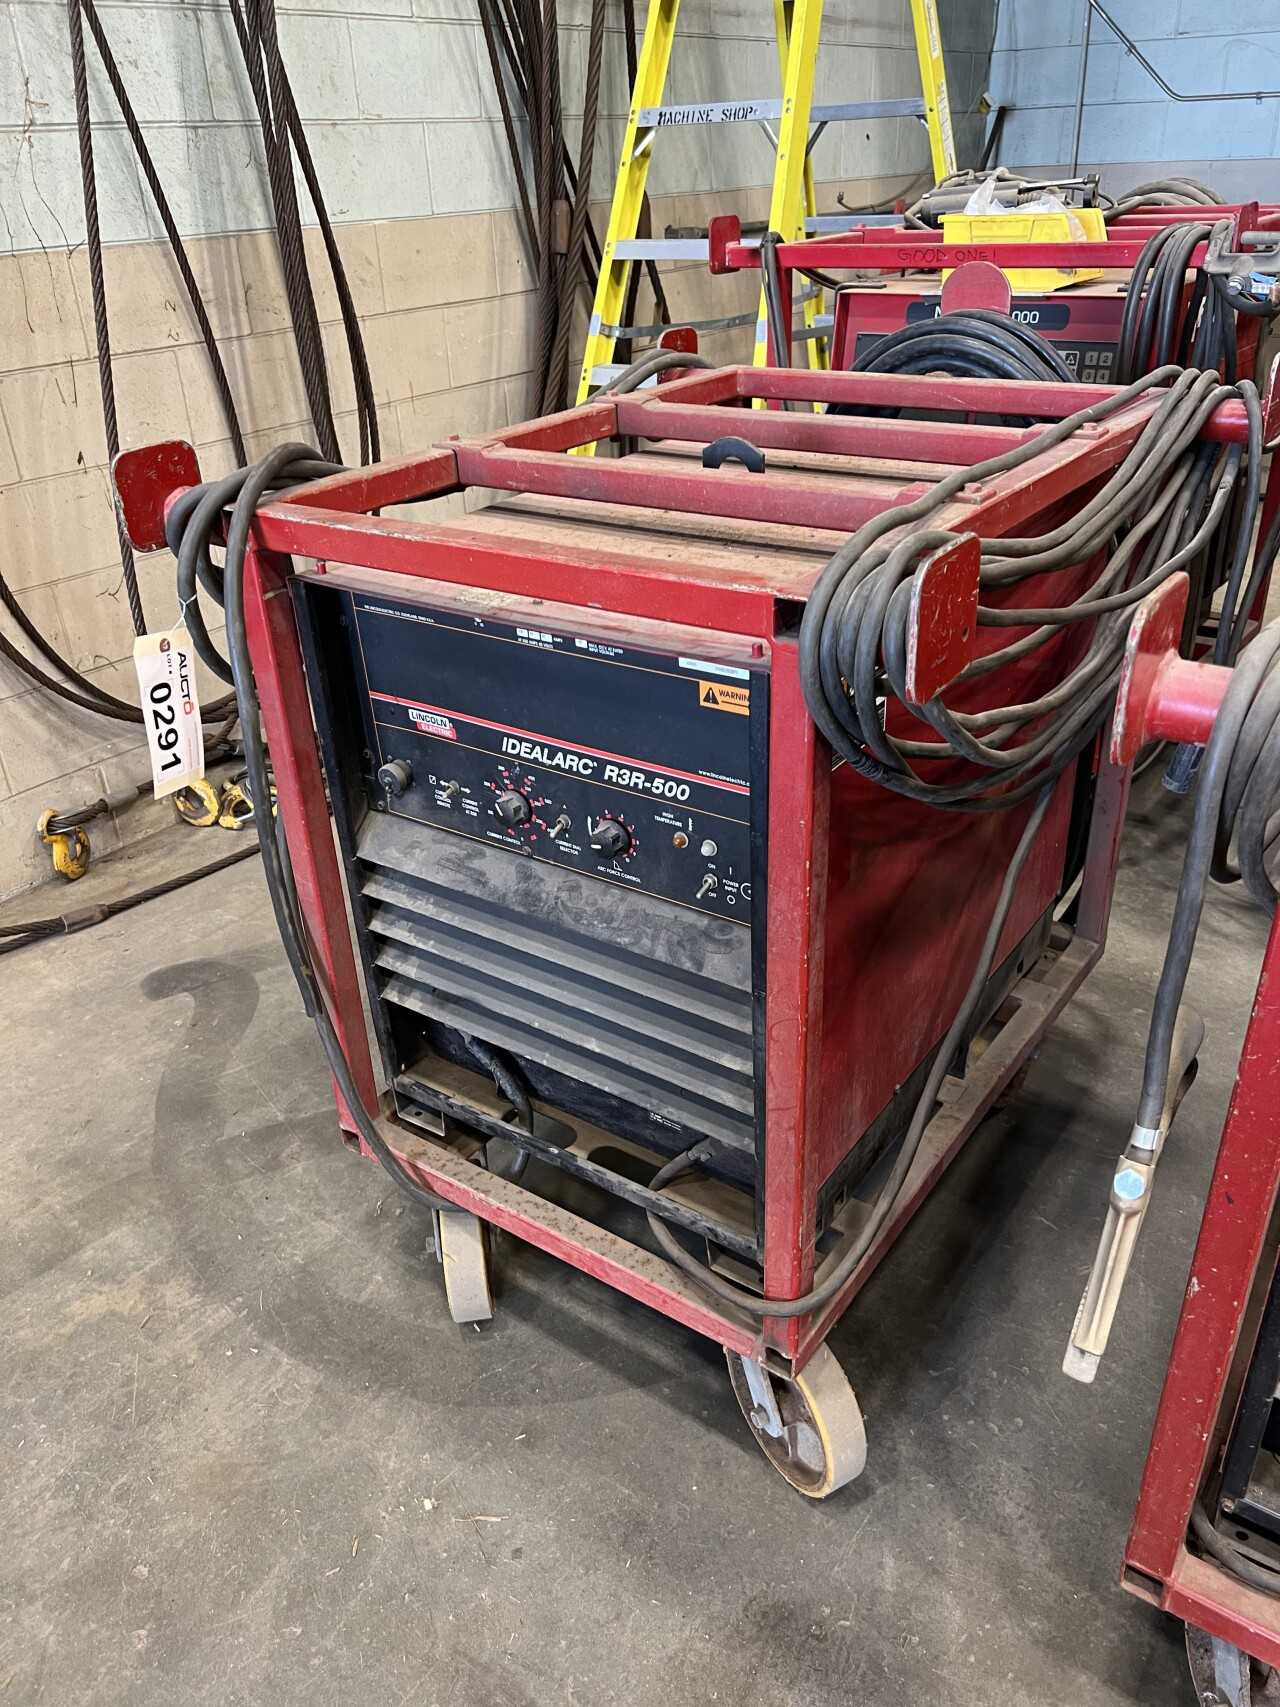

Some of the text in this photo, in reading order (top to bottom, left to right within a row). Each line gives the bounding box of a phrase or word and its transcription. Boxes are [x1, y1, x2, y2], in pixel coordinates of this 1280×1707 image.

[657, 106, 753, 126] MACHINE SHOP
[896, 248, 996, 263] GOOD ONE!
[1011, 310, 1040, 325] 000
[718, 688, 748, 702] WARNIN
[150, 682, 182, 772] 0291
[411, 711, 448, 728] LINCOLN
[421, 724, 453, 738] ELECTRIC
[603, 764, 691, 801] R3R-500
[722, 879, 739, 888] POWER
